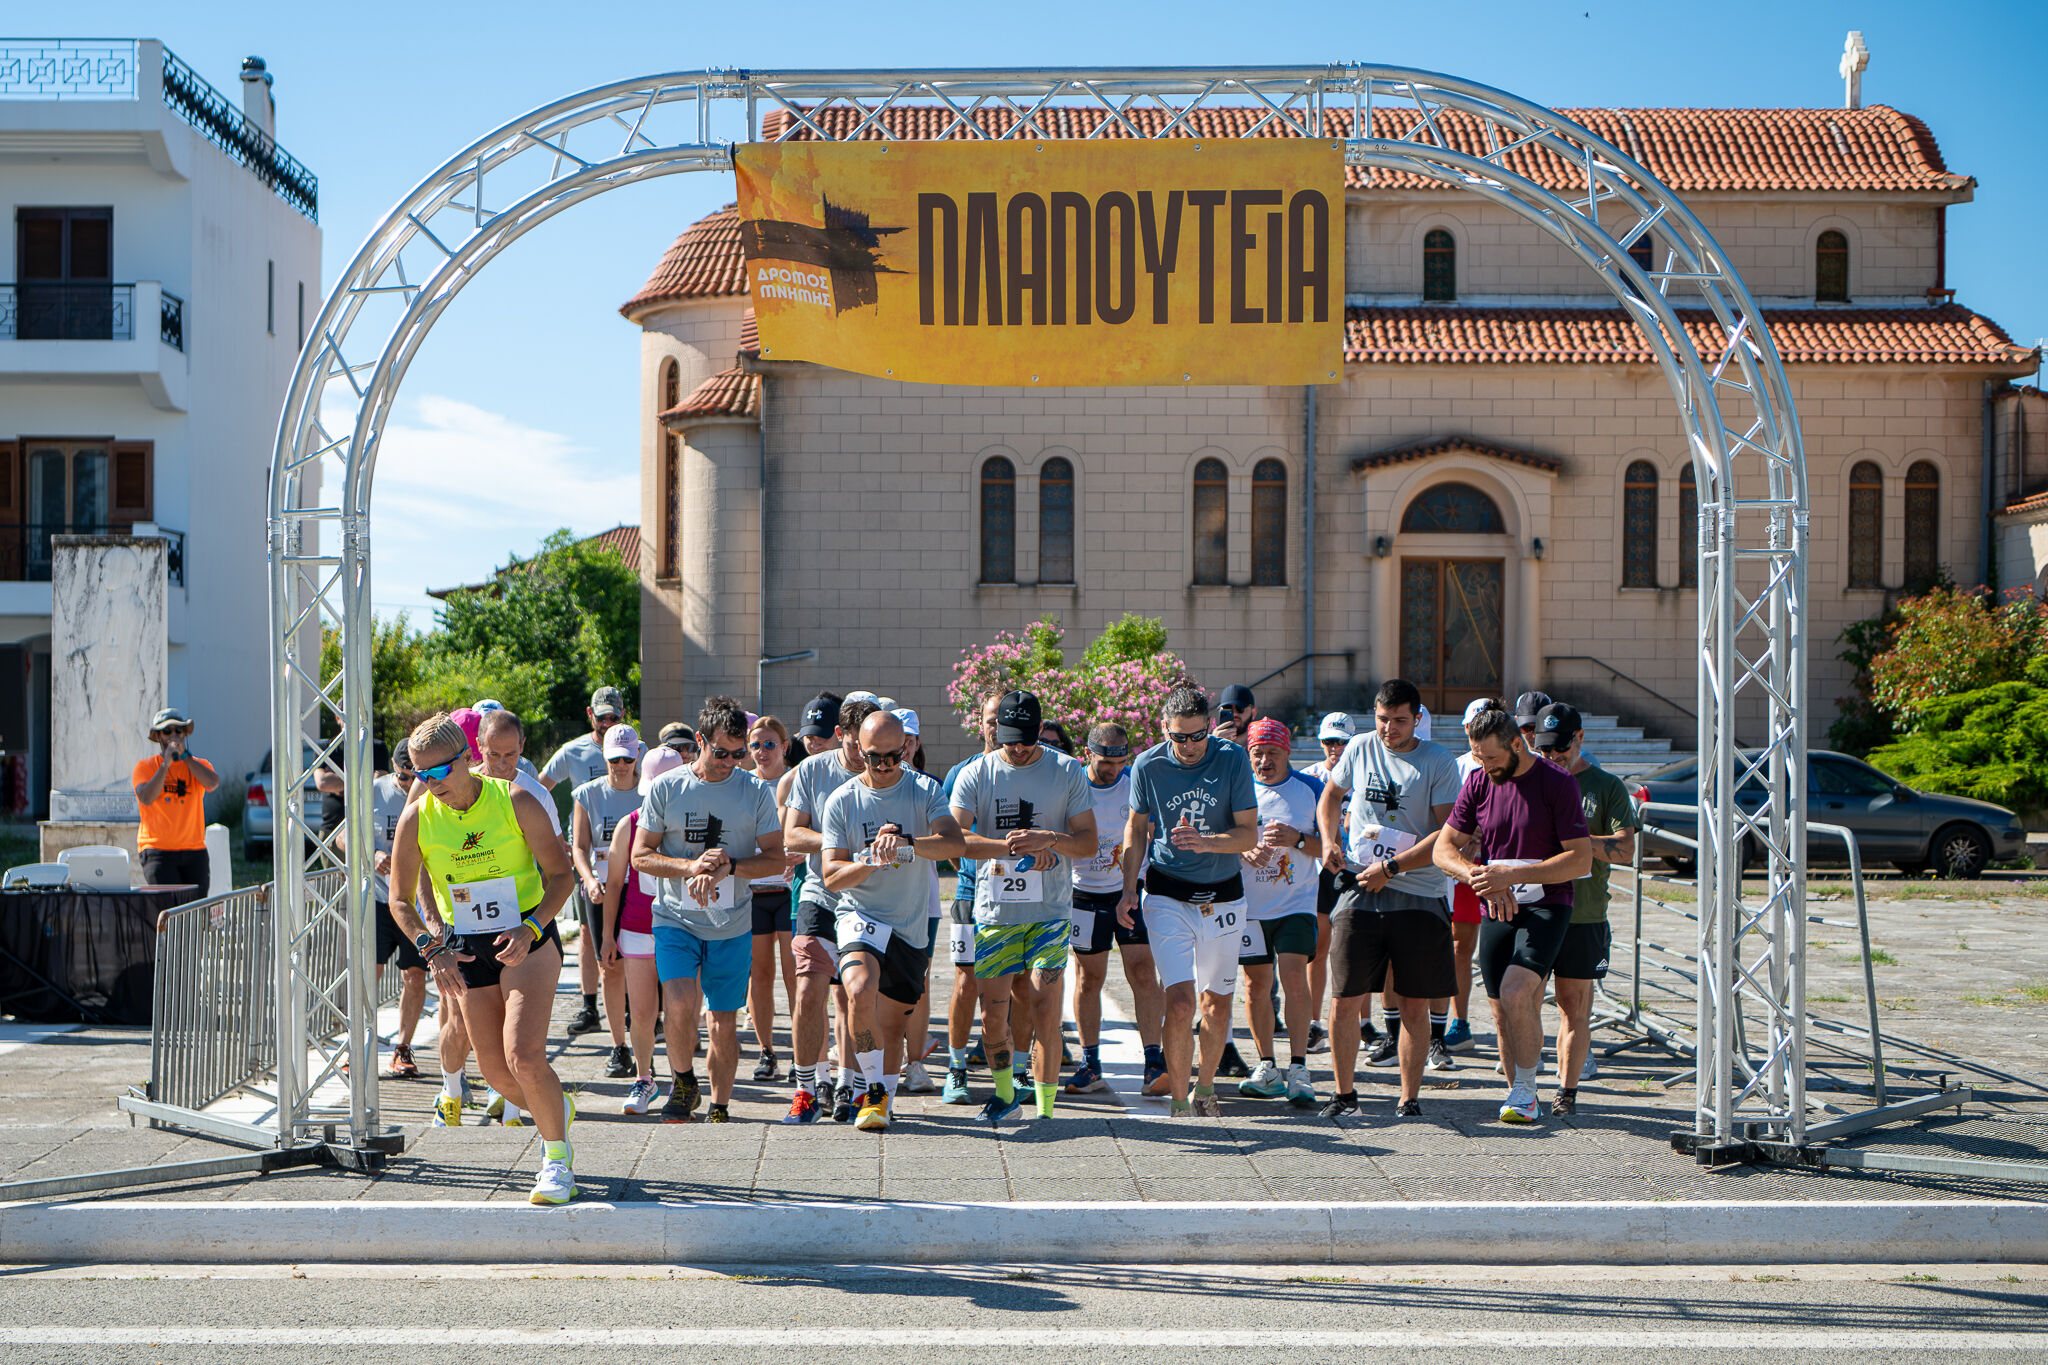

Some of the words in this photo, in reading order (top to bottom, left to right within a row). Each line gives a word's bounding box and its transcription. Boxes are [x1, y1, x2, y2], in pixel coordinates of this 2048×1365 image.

[918, 189, 1330, 326] ΠΛΑΠΟΥΤΕΙΑ
[757, 267, 829, 290] ΔΡΟΜΟΣ
[760, 284, 831, 307] ΜΝΗΜΗΣ
[1166, 795, 1182, 811] 50
[1182, 787, 1218, 807] miles
[1000, 818, 1009, 827] 21
[688, 832, 697, 841] 21
[455, 849, 495, 862] ΜΑΡΑΘΩΝΙΟΣ
[1373, 843, 1396, 859] 05
[1003, 878, 1027, 892] 29
[471, 901, 500, 921] 15
[854, 921, 877, 935] 06
[1214, 912, 1236, 929] 10
